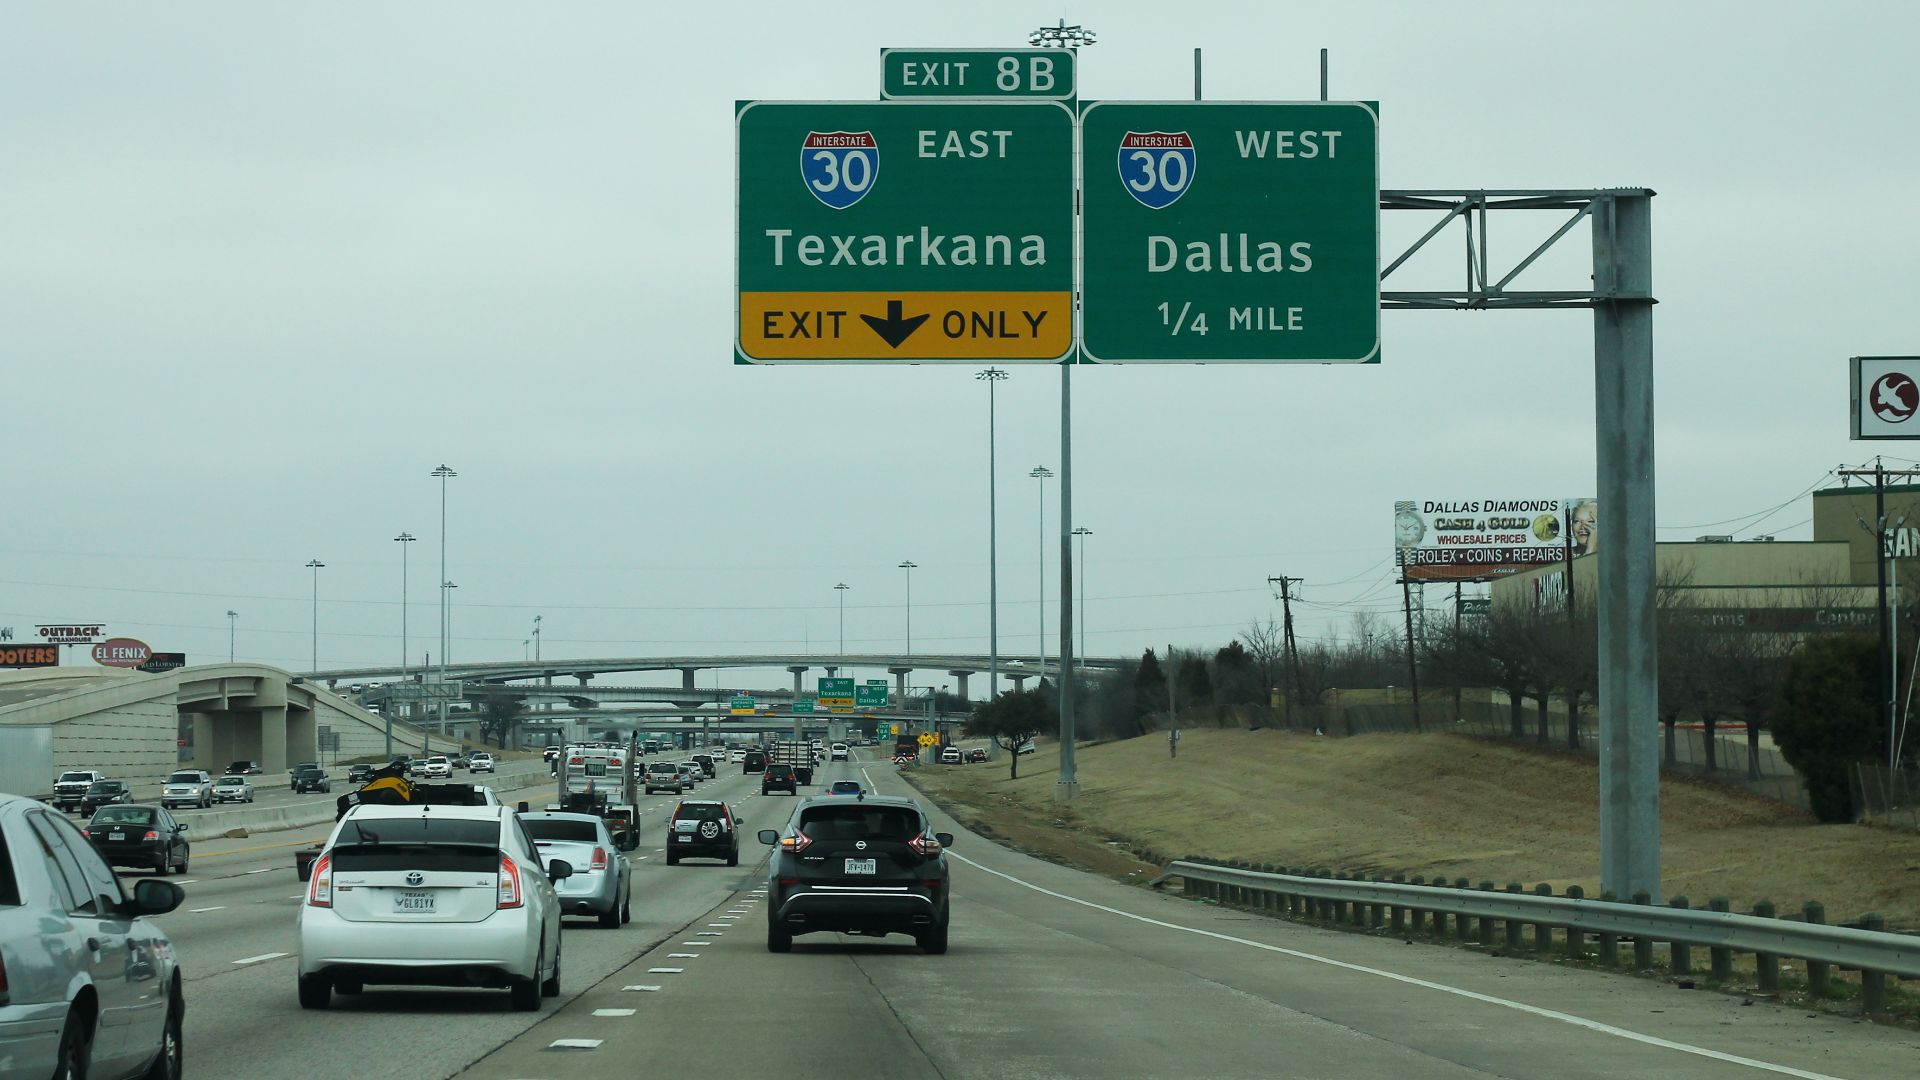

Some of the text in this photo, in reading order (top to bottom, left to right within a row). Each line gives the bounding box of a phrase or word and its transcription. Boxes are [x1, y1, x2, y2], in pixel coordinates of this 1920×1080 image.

[904, 56, 1055, 92] EXIT 8B
[812, 136, 867, 147] INTERSTATE
[918, 130, 1013, 158] EAST
[1130, 136, 1183, 147] INTERSTATE
[1236, 131, 1342, 159] WEST
[812, 151, 872, 192] 30
[1129, 151, 1188, 192] 30
[766, 227, 1047, 266] Texarkana
[1148, 233, 1313, 273] Dallas
[763, 311, 1048, 339] EXIT ONLY
[1158, 302, 1304, 336] 1/4 MILE
[1423, 500, 1559, 514] DALLAS DIAMONDS
[1434, 518, 1475, 531] CASH
[1487, 517, 1530, 530] GOLD
[1437, 534, 1527, 545] WHOLESALE PRICES
[1419, 547, 1564, 563] ROLEX COINS REPAIRS
[40, 627, 100, 638] OUTBACK
[96, 647, 147, 660] EL FENIX
